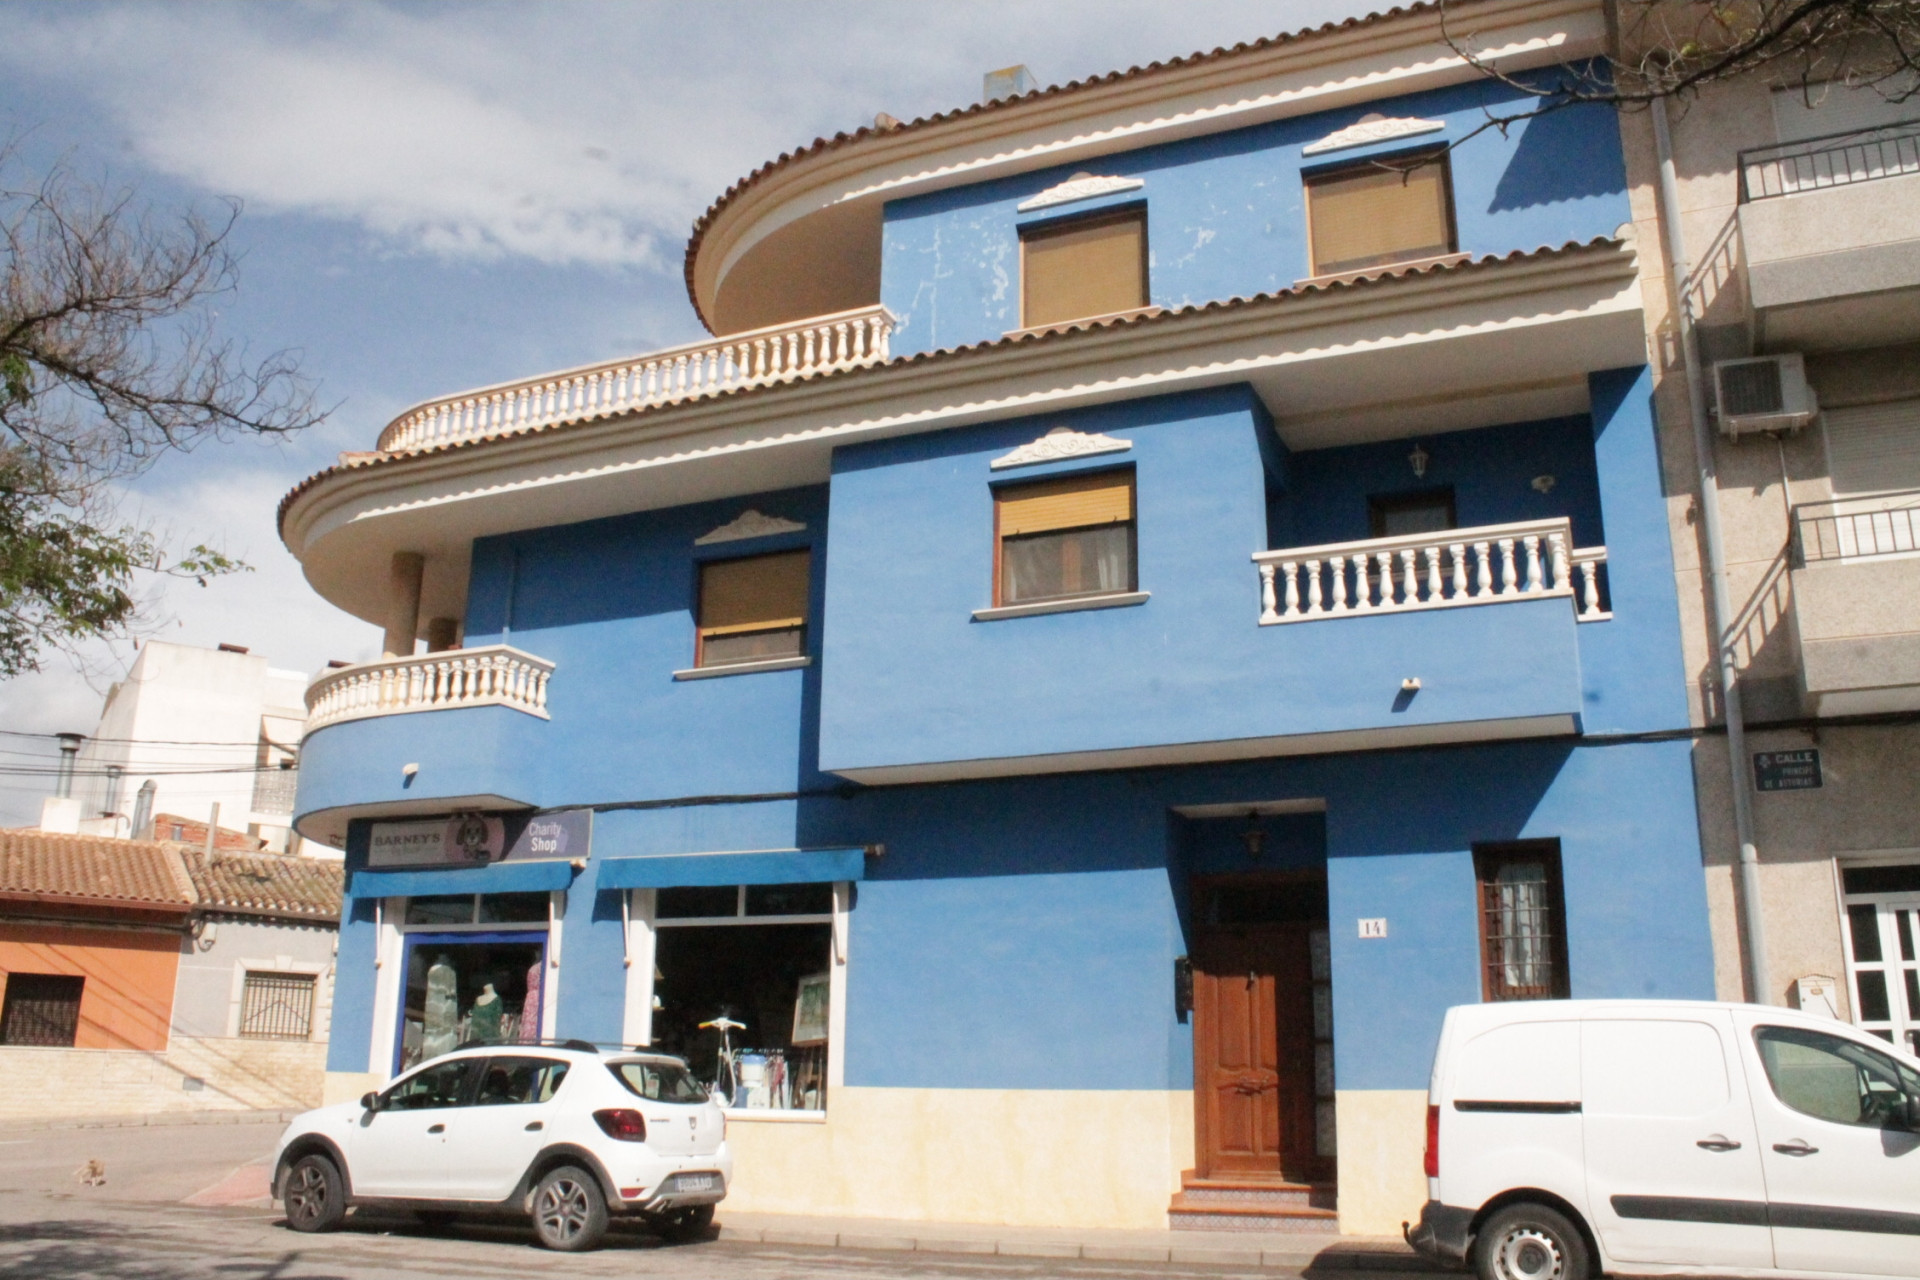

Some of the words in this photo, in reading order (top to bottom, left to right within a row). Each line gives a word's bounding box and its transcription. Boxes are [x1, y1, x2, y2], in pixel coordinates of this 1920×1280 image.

[1775, 752, 1813, 764] CALLE
[529, 822, 563, 838] Charity
[374, 833, 441, 846] BARNEY'S
[531, 837, 557, 853] Shop
[1365, 921, 1380, 935] 14
